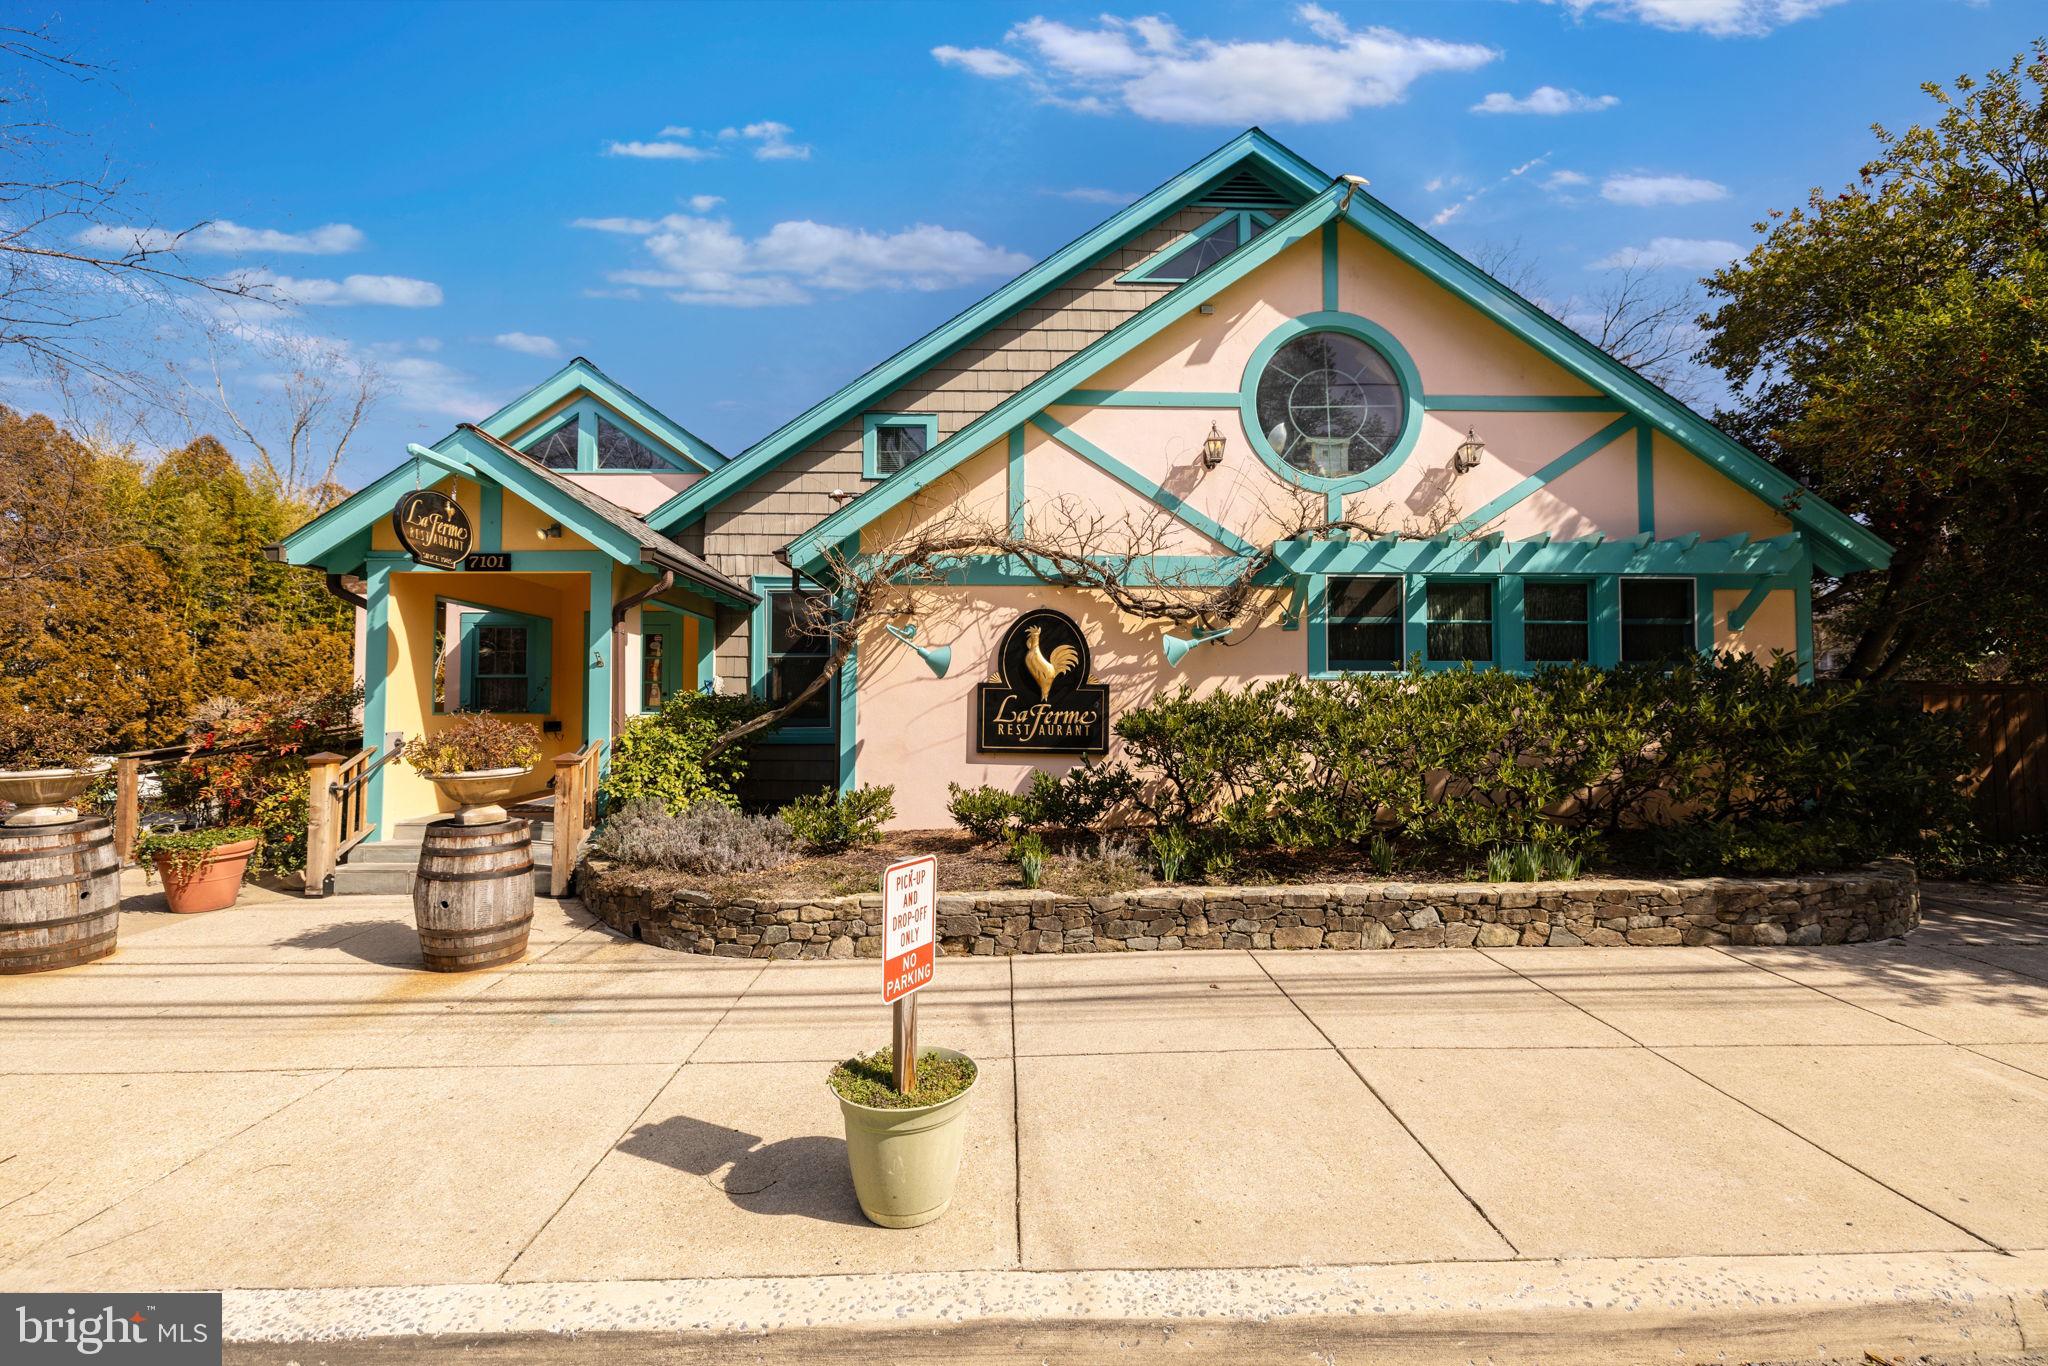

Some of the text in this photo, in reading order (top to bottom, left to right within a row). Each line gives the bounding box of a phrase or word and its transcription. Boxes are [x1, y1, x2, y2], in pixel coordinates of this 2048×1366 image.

[406, 499, 468, 547] La Ferme
[409, 527, 465, 552] RESTAURANT
[469, 556, 504, 568] 7101
[993, 694, 1097, 742] La Ferme
[998, 723, 1090, 736] RESTAURANT
[896, 869, 926, 891] PICK-UP
[903, 890, 918, 908] AND
[892, 905, 928, 931] DROP-OFF
[900, 926, 920, 947] ONLY
[902, 952, 917, 971] NO
[886, 963, 931, 997] PARKING
